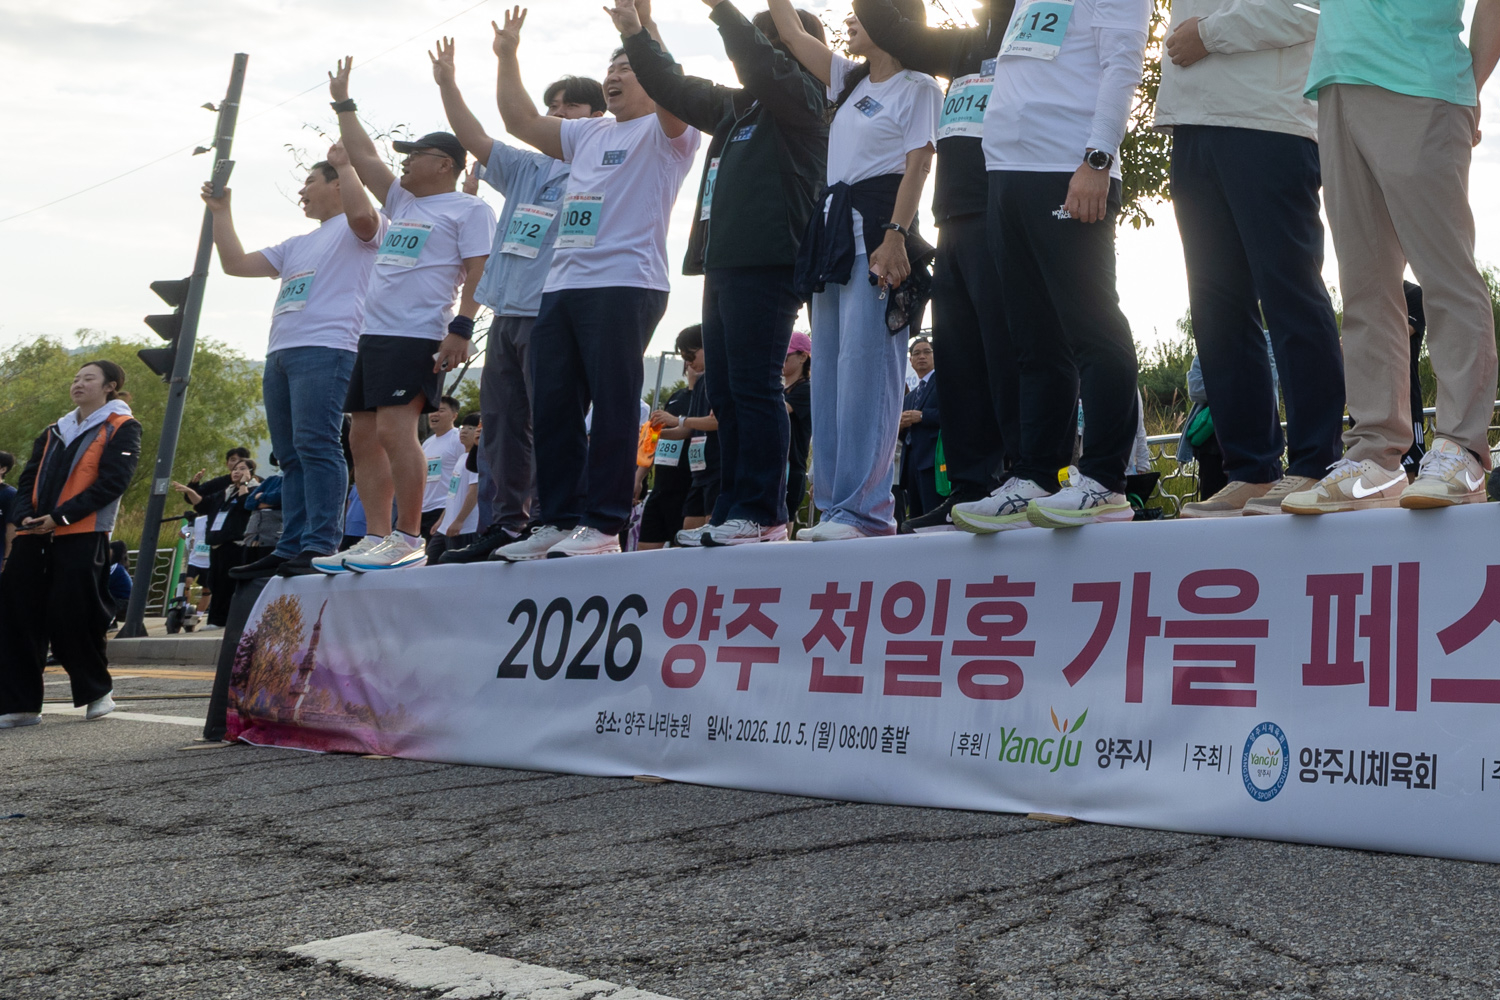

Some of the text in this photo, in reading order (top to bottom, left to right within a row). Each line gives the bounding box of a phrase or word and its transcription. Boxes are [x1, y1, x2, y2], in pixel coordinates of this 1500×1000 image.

[945, 94, 988, 116] 0014
[386, 234, 419, 249] 0010
[496, 593, 649, 682] 2026
[660, 585, 782, 691] 양주
[802, 575, 1036, 700] 천일홍
[1062, 568, 1269, 708] 가을
[595, 710, 910, 754] 장소: 양주 나리농원 일시: 2026. 10. 5. (월) 08:00 출발
[1249, 723, 1285, 744] 양주시체육회
[1095, 737, 1152, 771] 양주시
[1299, 747, 1438, 790] 양주시체육회
[1257, 769, 1271, 778] 양주시
[1257, 787, 1278, 800] SPORTS
[1277, 754, 1289, 788] COUNCIL
